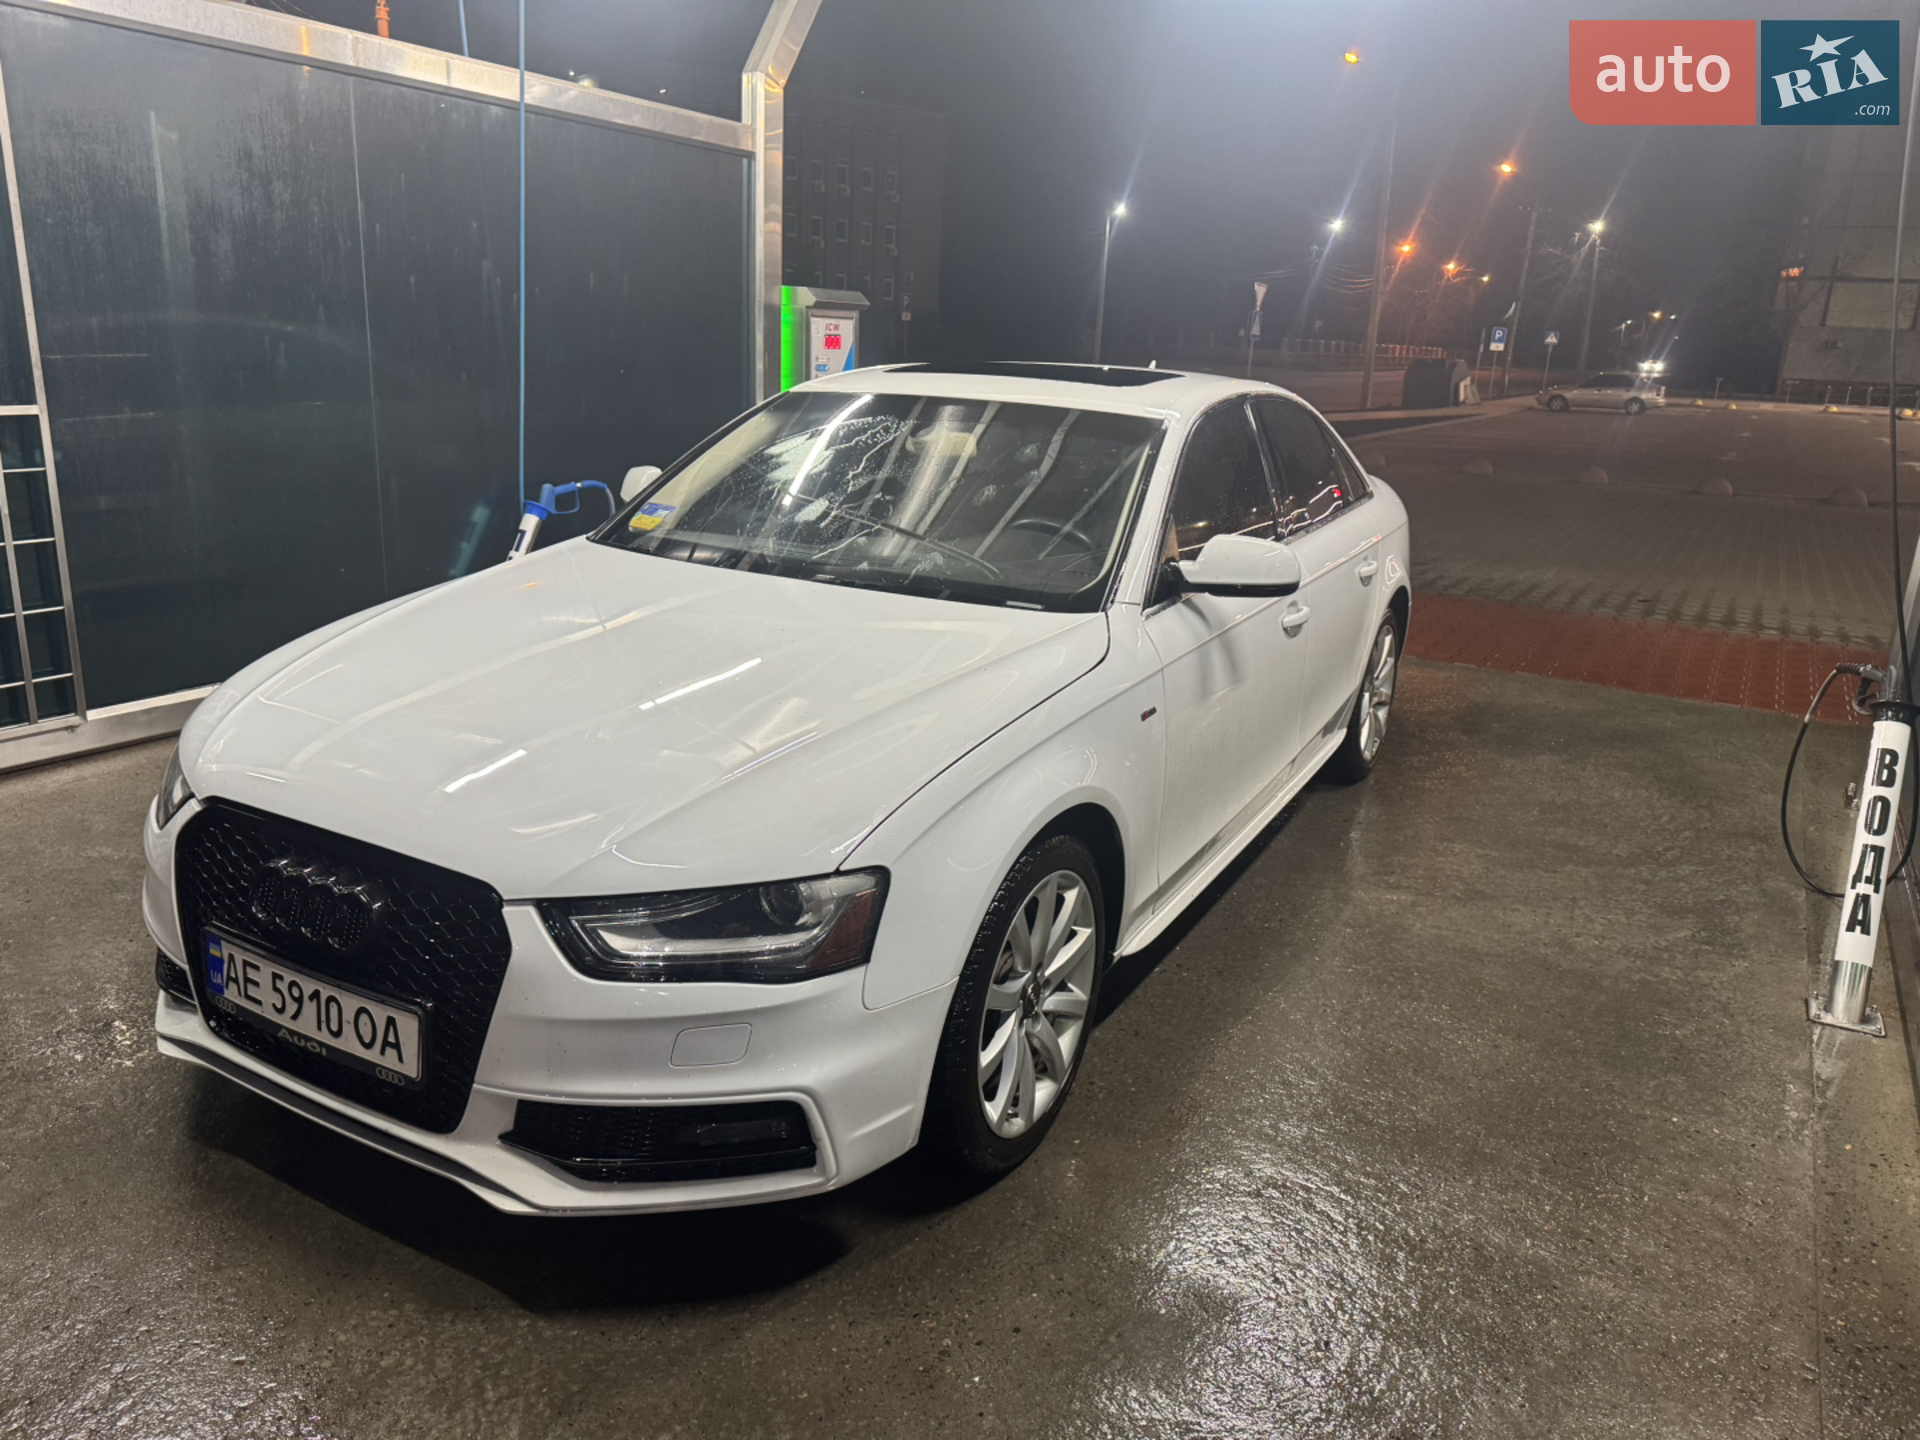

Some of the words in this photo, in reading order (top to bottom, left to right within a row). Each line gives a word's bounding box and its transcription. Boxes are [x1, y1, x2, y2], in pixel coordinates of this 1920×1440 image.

[1495, 330, 1503, 340] P
[1845, 747, 1899, 937] ВОДА
[210, 969, 223, 986] UA
[225, 952, 263, 1007] AE
[271, 971, 343, 1038] 5910
[354, 1006, 405, 1064] OA
[277, 1028, 327, 1056] Audi
